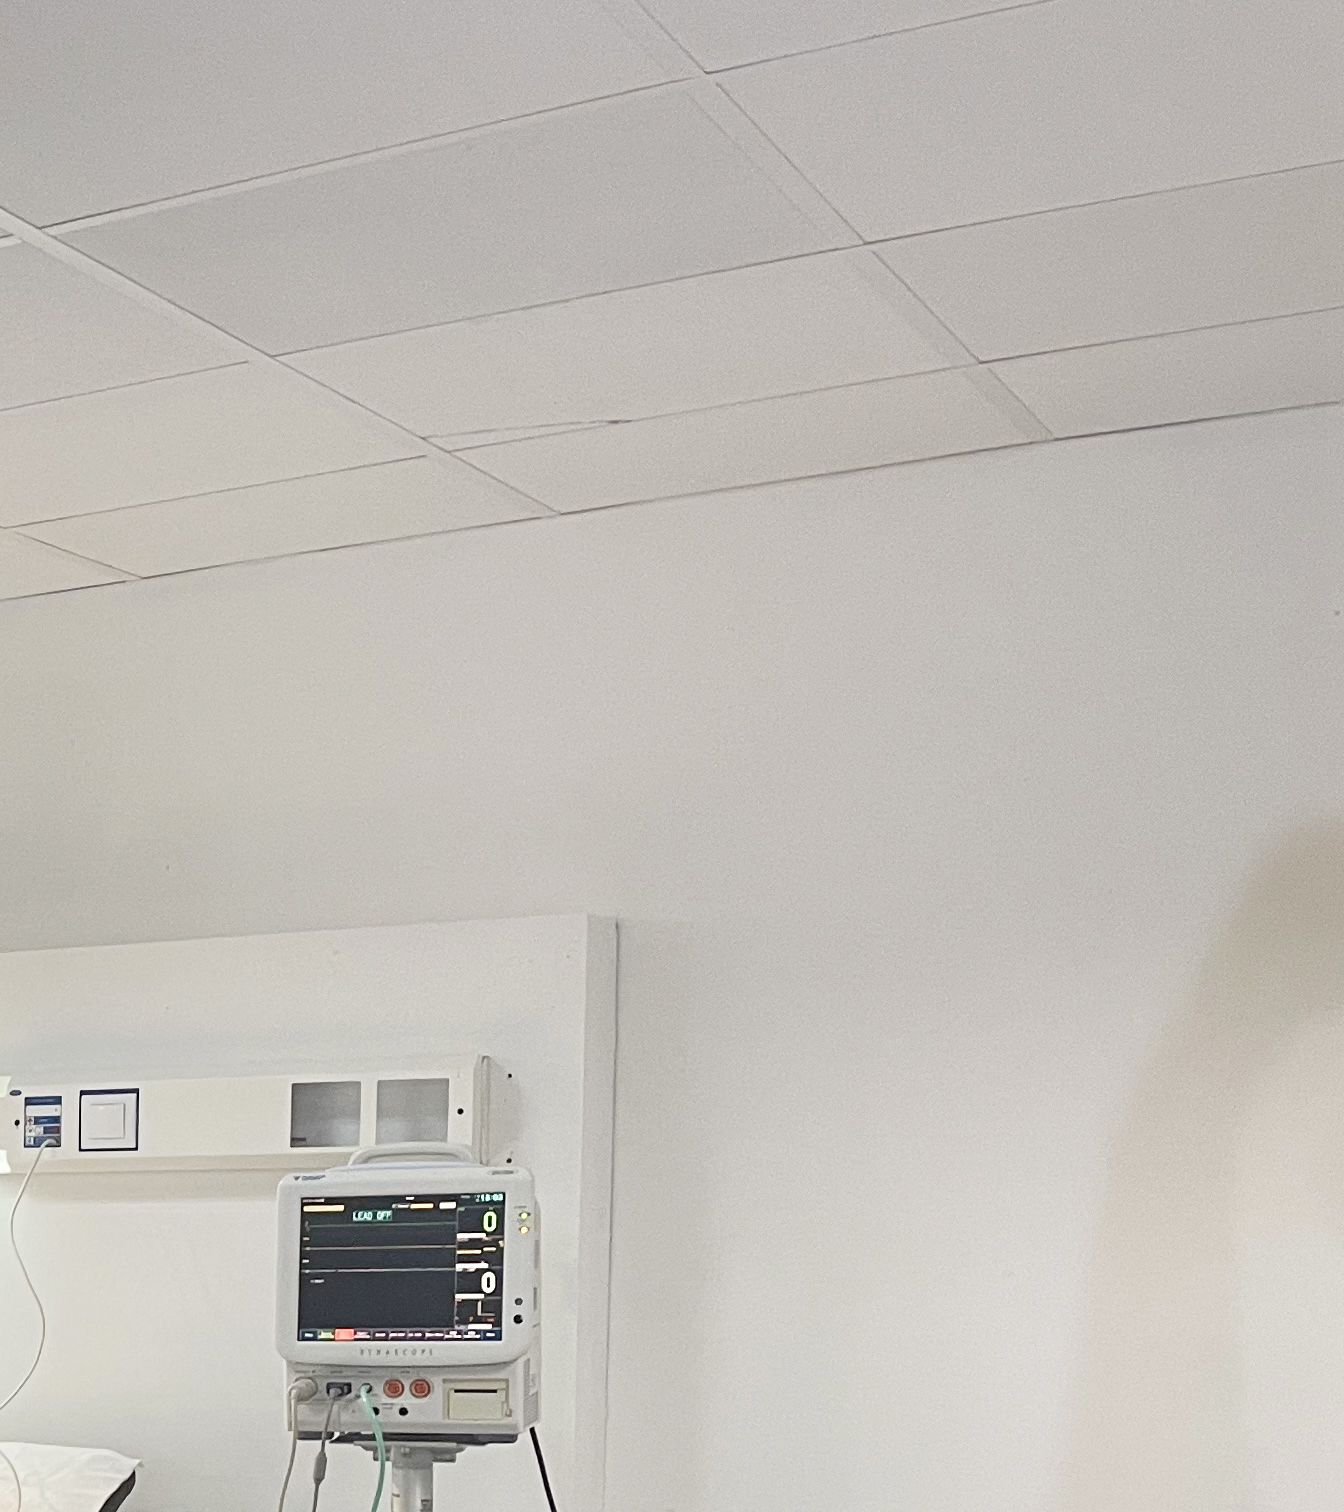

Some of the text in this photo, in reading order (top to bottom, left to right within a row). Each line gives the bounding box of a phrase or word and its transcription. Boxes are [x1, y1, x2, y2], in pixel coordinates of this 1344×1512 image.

[353, 1210, 393, 1222] LEAD OFF
[483, 1210, 497, 1232] 0
[481, 1271, 496, 1294] 0
